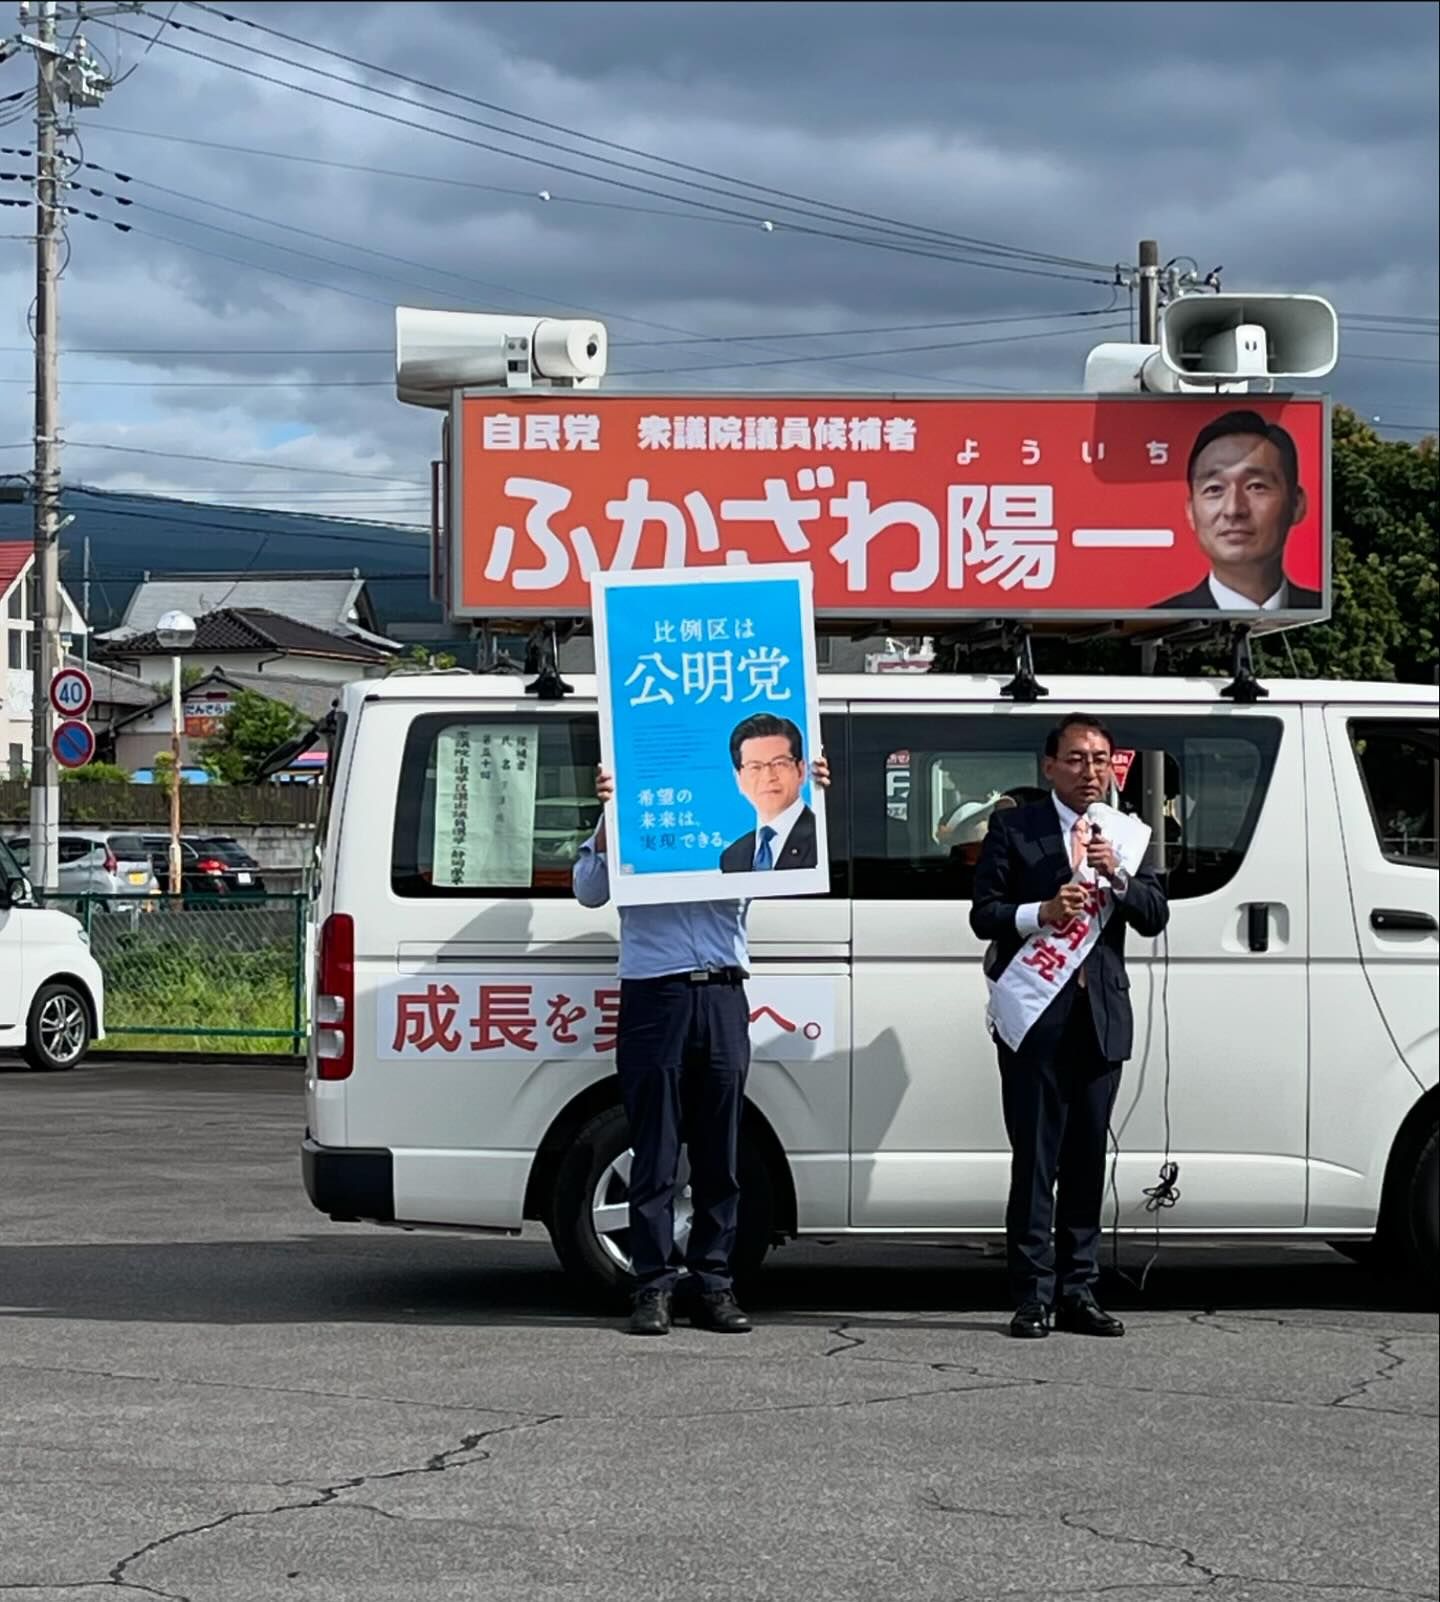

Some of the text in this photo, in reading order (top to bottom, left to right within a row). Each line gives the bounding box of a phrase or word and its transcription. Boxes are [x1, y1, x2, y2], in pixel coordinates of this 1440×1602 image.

[483, 413, 600, 451] 自民党
[638, 415, 917, 451] 衆議院議員候補者
[484, 466, 1175, 592] ふかざわ陽一
[653, 617, 756, 643] 比例区は
[59, 682, 82, 703] 40
[623, 646, 792, 707] 公明党
[638, 787, 693, 806] 希望の
